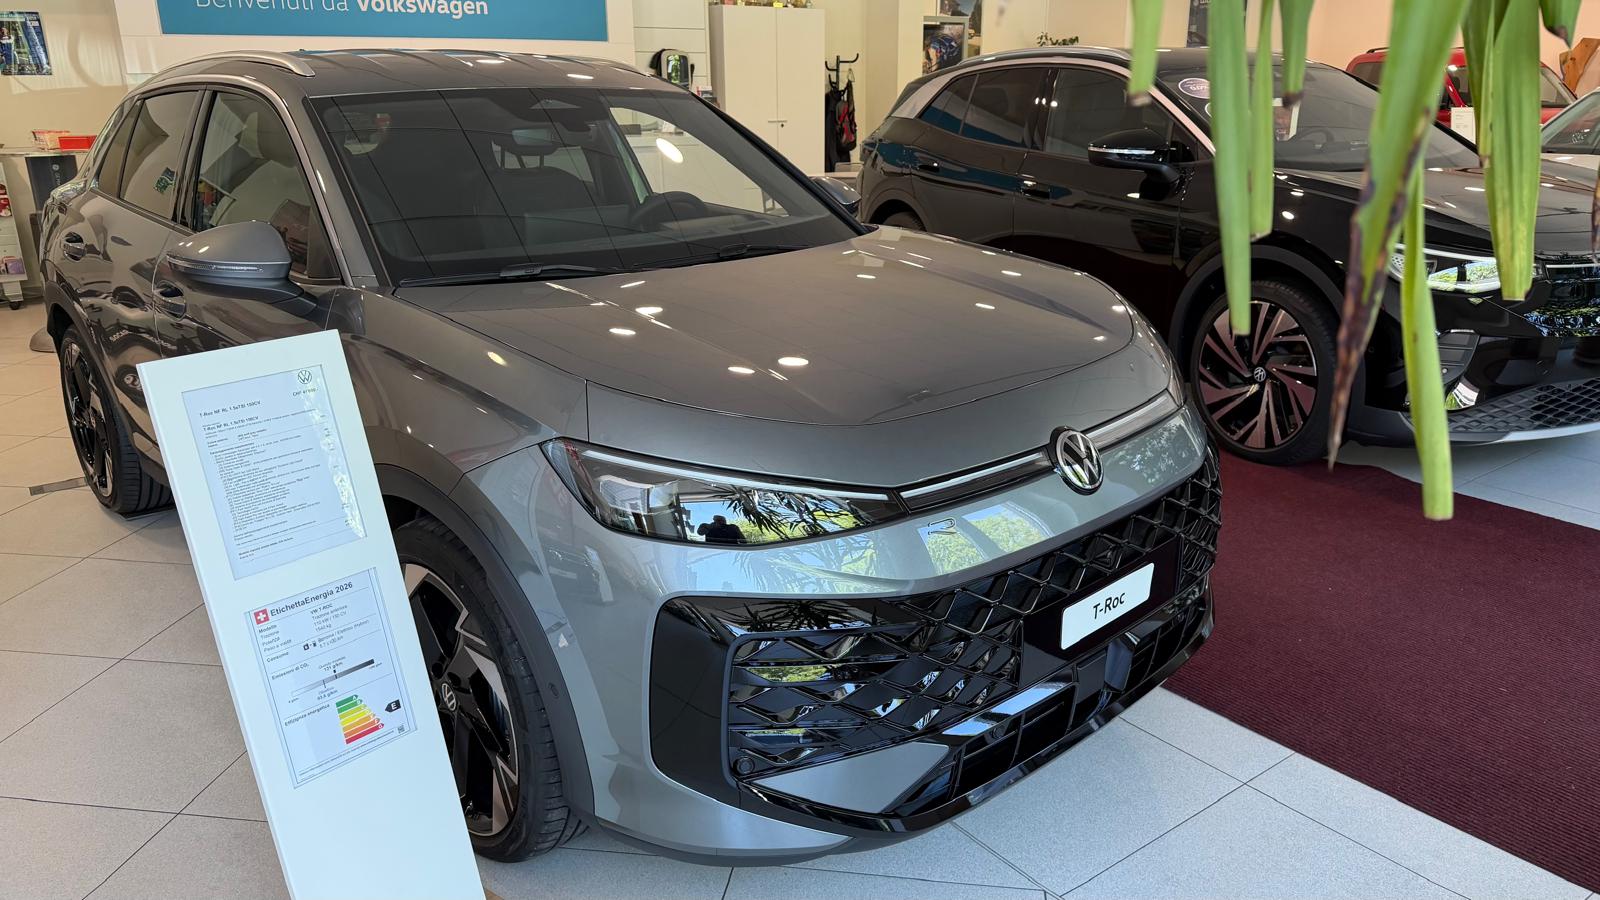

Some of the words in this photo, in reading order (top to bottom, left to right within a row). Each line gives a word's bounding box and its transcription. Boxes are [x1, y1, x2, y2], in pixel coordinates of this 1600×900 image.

[322, 0, 349, 11] da
[357, 0, 488, 19] Volkswagen
[270, 588, 334, 617] EtichettaEnergia
[335, 581, 353, 594] 2026
[1092, 592, 1126, 620] T-Roc
